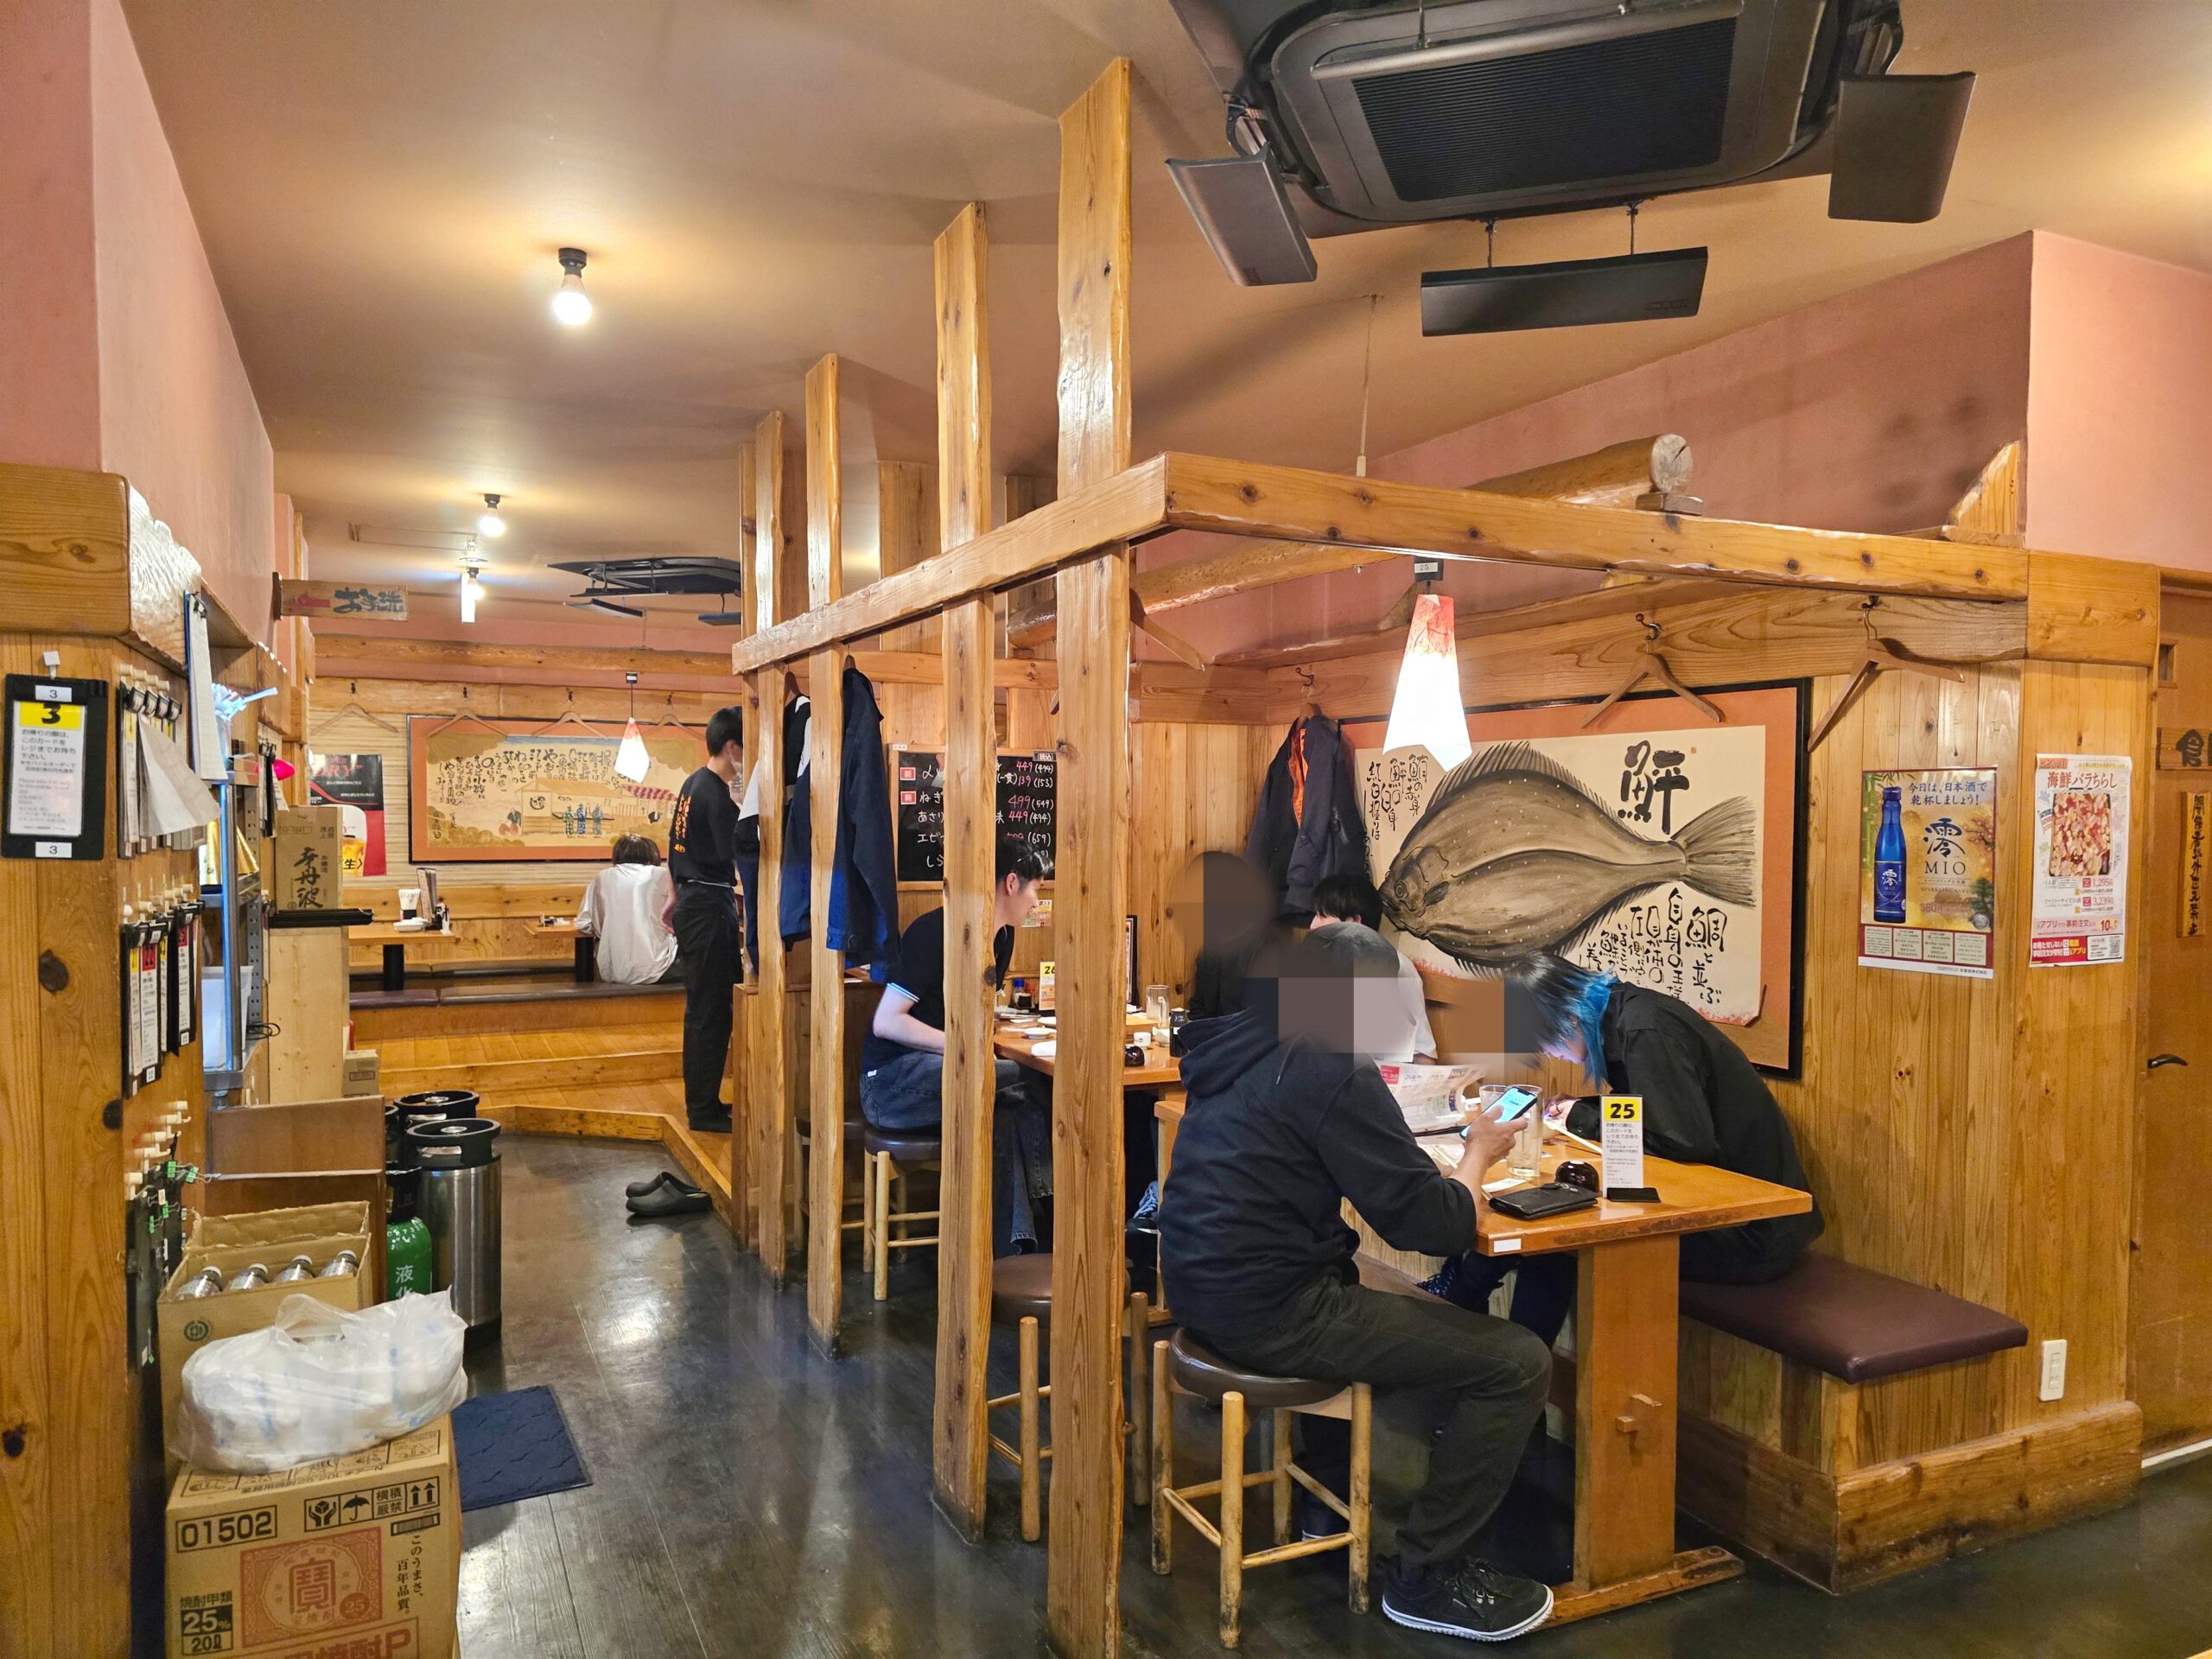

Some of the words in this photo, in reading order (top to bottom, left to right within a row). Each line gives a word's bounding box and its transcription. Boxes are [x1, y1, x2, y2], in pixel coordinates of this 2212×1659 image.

[49, 690, 58, 699] 3
[41, 702, 61, 724] 3
[22, 737, 67, 746] このカードを
[22, 746, 77, 754] レジまでお持ち
[1018, 775, 1032, 785] 139
[1033, 777, 1053, 789] (153)
[1908, 781, 1987, 794] 今日は、日本酒で
[1007, 794, 1031, 809] 499
[1032, 798, 1054, 810] (549)
[1008, 810, 1028, 824] 449
[918, 831, 944, 843] エビ
[1028, 832, 1052, 847] (659)
[1923, 817, 1966, 858] 澪
[49, 845, 58, 855] 3
[1924, 861, 1966, 874] MIO
[1686, 906, 1727, 1004] 鯛と並ぶ
[1610, 1103, 1635, 1119] 25
[181, 1512, 272, 1547] 01502
[397, 1558, 410, 1614] 百年品質。
[344, 1600, 365, 1613] 25
[183, 1610, 231, 1634] 25%
